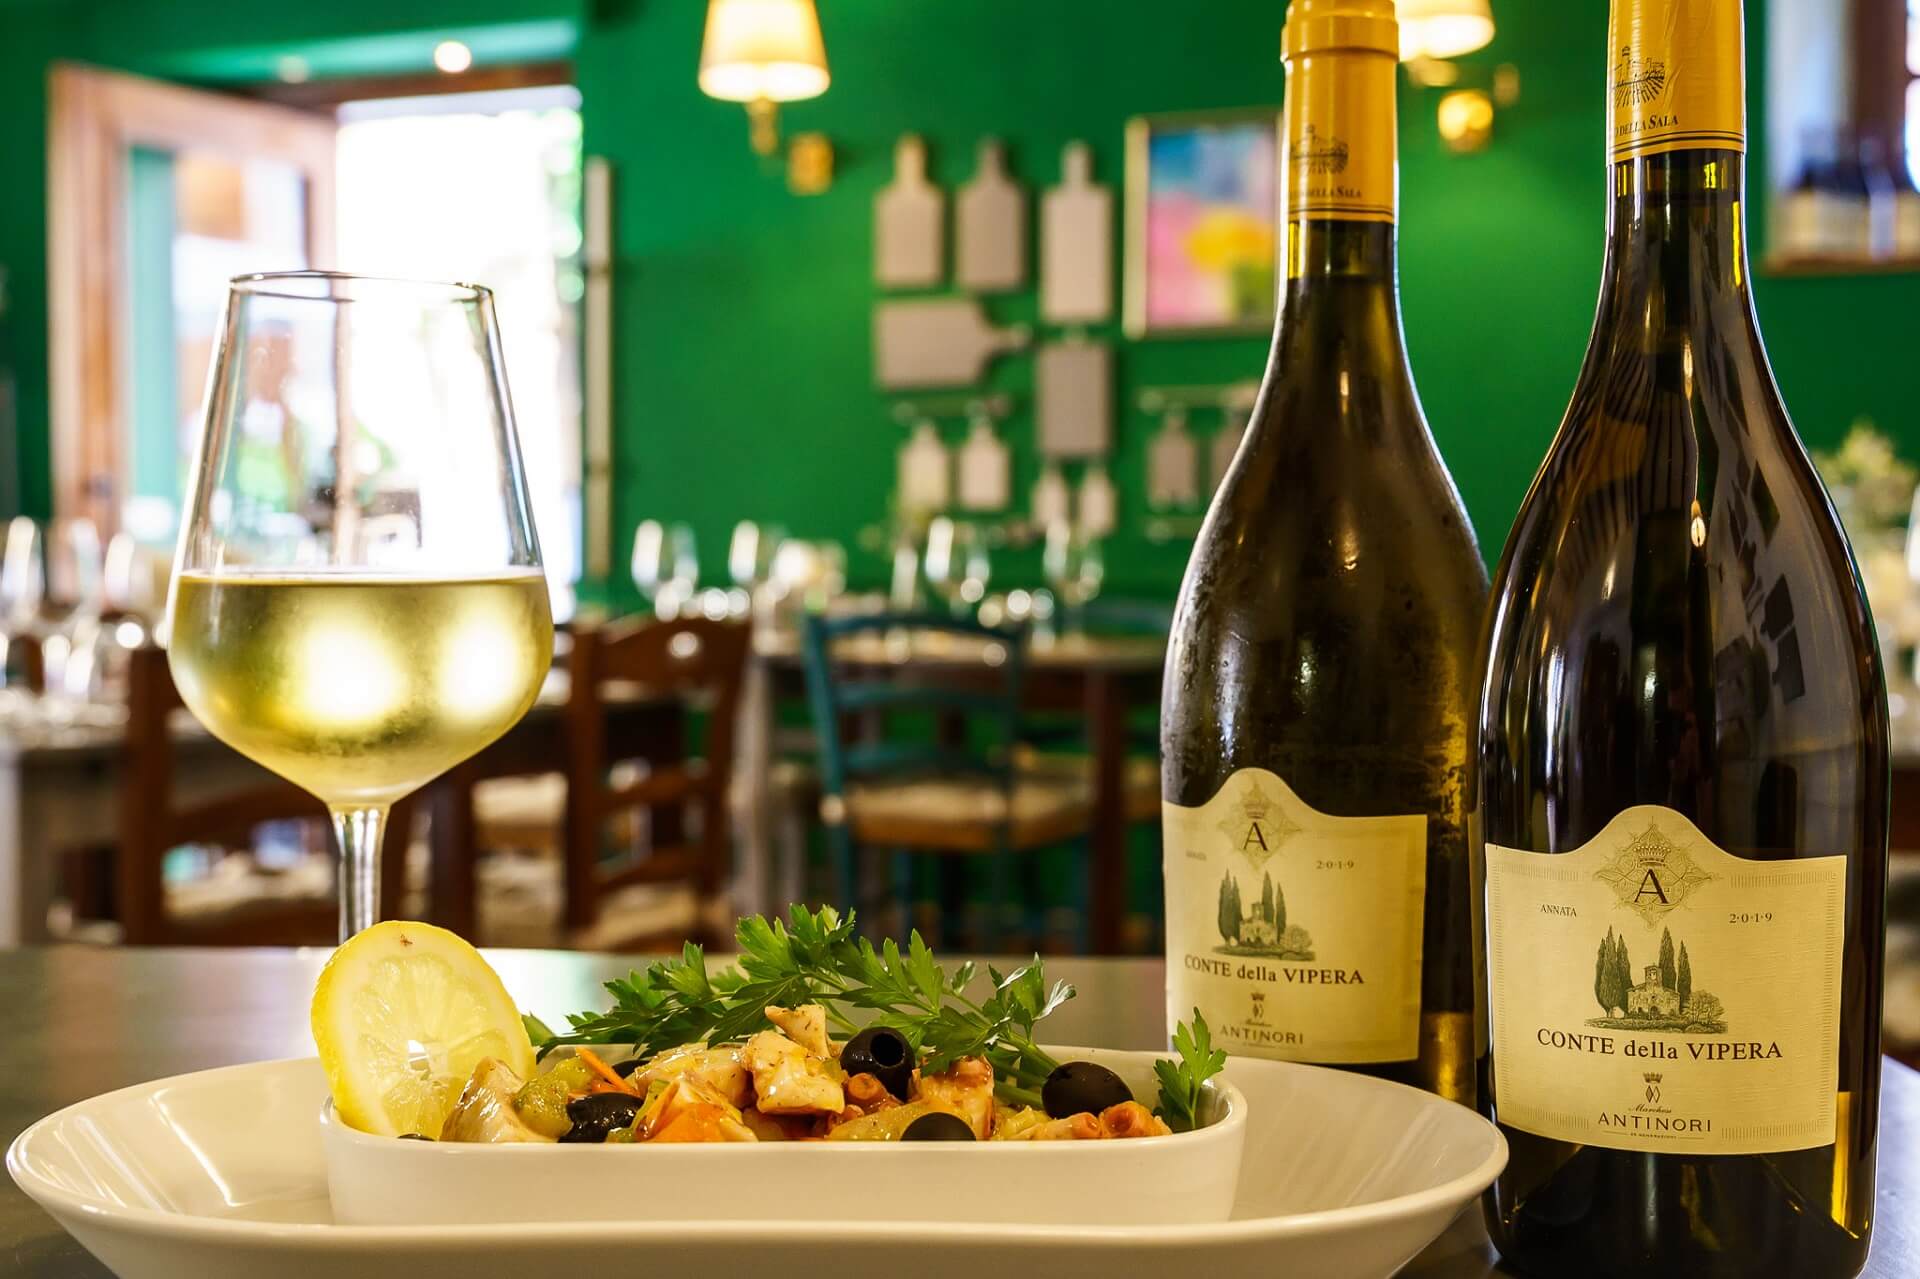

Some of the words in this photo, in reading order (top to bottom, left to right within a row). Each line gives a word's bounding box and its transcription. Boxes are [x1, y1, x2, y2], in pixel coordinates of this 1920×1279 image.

[1243, 821, 1268, 852] A
[1634, 868, 1669, 904] A
[1540, 903, 1578, 918] ANNATA
[1184, 954, 1232, 978] CONTE
[1237, 965, 1277, 983] della
[1282, 968, 1365, 985] VIPERA
[1220, 1024, 1304, 1045] ANTINORI
[1537, 1027, 1615, 1055] CONTE
[1623, 1041, 1679, 1060] della
[1686, 1041, 1783, 1061] VIPERA
[1598, 1112, 1711, 1133] ANTINORI
